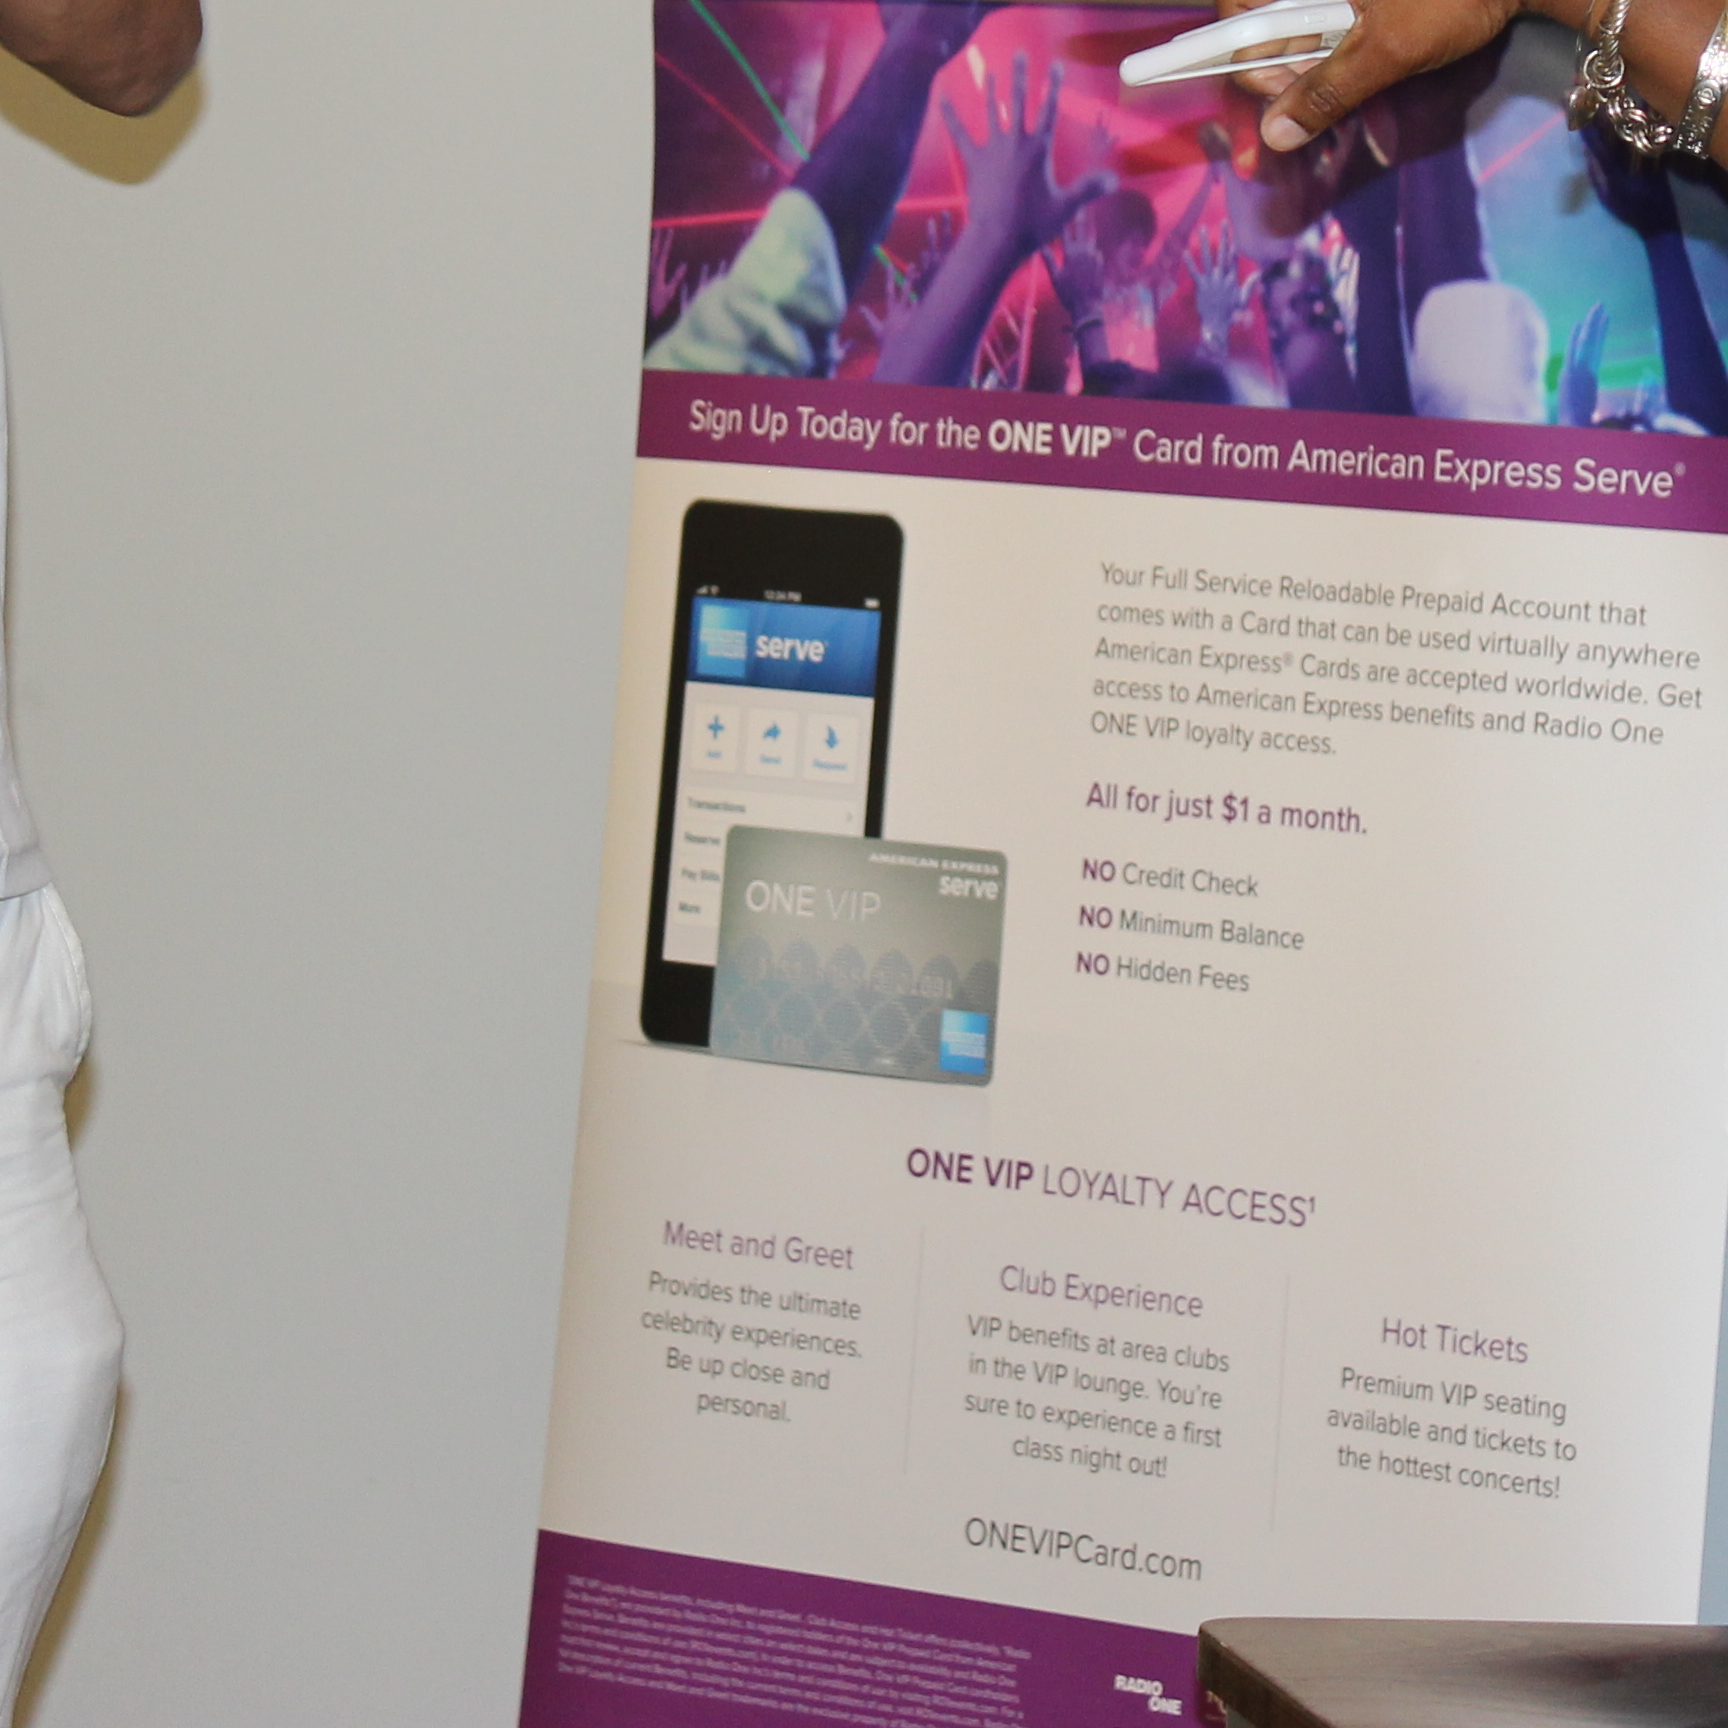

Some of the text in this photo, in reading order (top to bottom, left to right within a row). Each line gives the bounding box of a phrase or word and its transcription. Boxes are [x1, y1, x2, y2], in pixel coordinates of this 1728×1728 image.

[689, 398, 743, 441] Sign
[749, 403, 789, 443] Up
[797, 405, 883, 451] Today
[889, 411, 930, 446] for
[935, 415, 981, 451] the
[987, 418, 1054, 456] ONE
[1132, 428, 1204, 466] Card
[1211, 433, 1280, 470] from
[1286, 439, 1425, 480] American
[1433, 448, 1562, 492] Express
[1100, 561, 1648, 628] Your Full Service Reloadable Prepaid Account that
[754, 634, 826, 663] serve
[1097, 604, 1701, 671] comes with a Card that can be used virtually anywhere
[1094, 636, 1193, 666] American
[1299, 652, 1361, 682] Cards
[1366, 664, 1400, 685] are
[1405, 667, 1508, 695] accepted
[1514, 674, 1648, 705] worldwide.
[1657, 682, 1703, 710] Get
[1090, 710, 1337, 755] ONE VIP loyalty access.
[1092, 678, 1665, 746] access to American Express benefits and Radio One
[1085, 781, 1367, 835] All for just $1 a month.
[868, 852, 1000, 876] AMERICAN EXPRESS
[938, 875, 1000, 901] serve
[1081, 857, 1259, 897] NO Credit Check
[744, 878, 882, 921] ONE VIP
[1078, 904, 1305, 951] NO Minimum Balance
[1075, 950, 1250, 993] NO Hidden Fees
[906, 1147, 975, 1185] ONE
[983, 1155, 1035, 1191] VIP
[1043, 1164, 1174, 1209] LOYALTY
[663, 1219, 854, 1271] Meet and Greet
[648, 1269, 862, 1321] Provides the ultimate
[999, 1264, 1204, 1319] Club Experience
[640, 1310, 863, 1358] celebrity experiences.
[967, 1313, 1230, 1373] VIP benefits at area clubs
[1381, 1316, 1529, 1364] Hot Tickets
[665, 1346, 831, 1391] Be up close and
[968, 1352, 987, 1375] in
[992, 1356, 1027, 1382] the
[1032, 1360, 1069, 1387] VIP
[1073, 1366, 1149, 1403] lounge.
[696, 1393, 792, 1423] personal.
[964, 1393, 1222, 1449] sure to experience a first
[1340, 1366, 1567, 1428] Premium VIP seating
[1012, 1435, 1168, 1479] class night out!
[1326, 1408, 1578, 1462] available and tickets to
[1337, 1444, 1561, 1499] the hottest concerts!
[964, 1516, 1202, 1581] ONEVIPCard.com
[1113, 1674, 1164, 1697] RADIO
[1147, 1695, 1183, 1716] ONE
